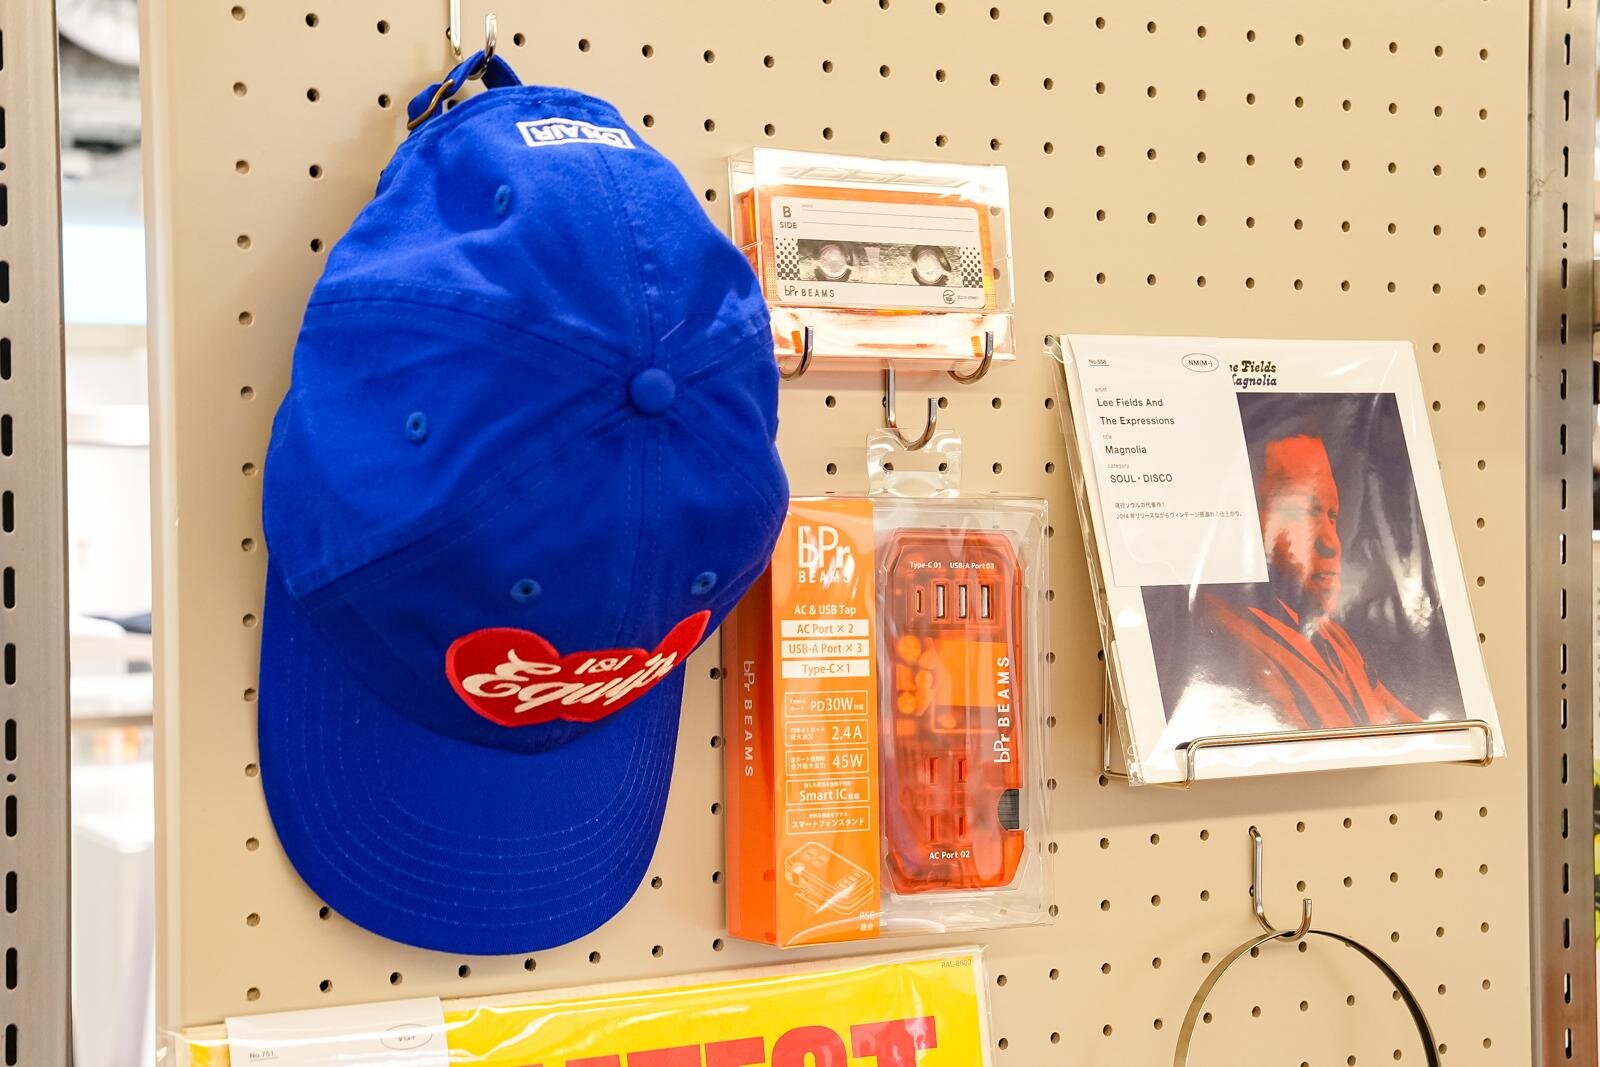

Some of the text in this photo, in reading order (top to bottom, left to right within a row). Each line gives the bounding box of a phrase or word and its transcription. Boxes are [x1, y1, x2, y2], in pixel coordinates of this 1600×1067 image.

[529, 124, 580, 141] AIR
[782, 205, 792, 218] B
[779, 221, 798, 229] SIDE
[801, 288, 835, 298] BEAMS
[1241, 360, 1277, 373] Fields
[1097, 398, 1164, 407] Lee Fields And
[1100, 416, 1175, 427] The Expressions
[1105, 445, 1147, 455] Magnolia
[797, 525, 851, 569] bPr
[798, 571, 852, 584] BEAMS
[794, 605, 857, 616] AC & USB Tap
[797, 624, 810, 634] AC
[812, 624, 833, 634] Port
[848, 624, 854, 633] 2
[789, 643, 819, 654] USB-A
[821, 643, 842, 653] Port
[857, 643, 863, 653] 3
[994, 656, 1010, 763] bPr BEAMS
[743, 660, 755, 776] bPr BEAMS
[800, 790, 833, 802] Smart
[941, 851, 959, 859] Port
[960, 850, 970, 858] 02
